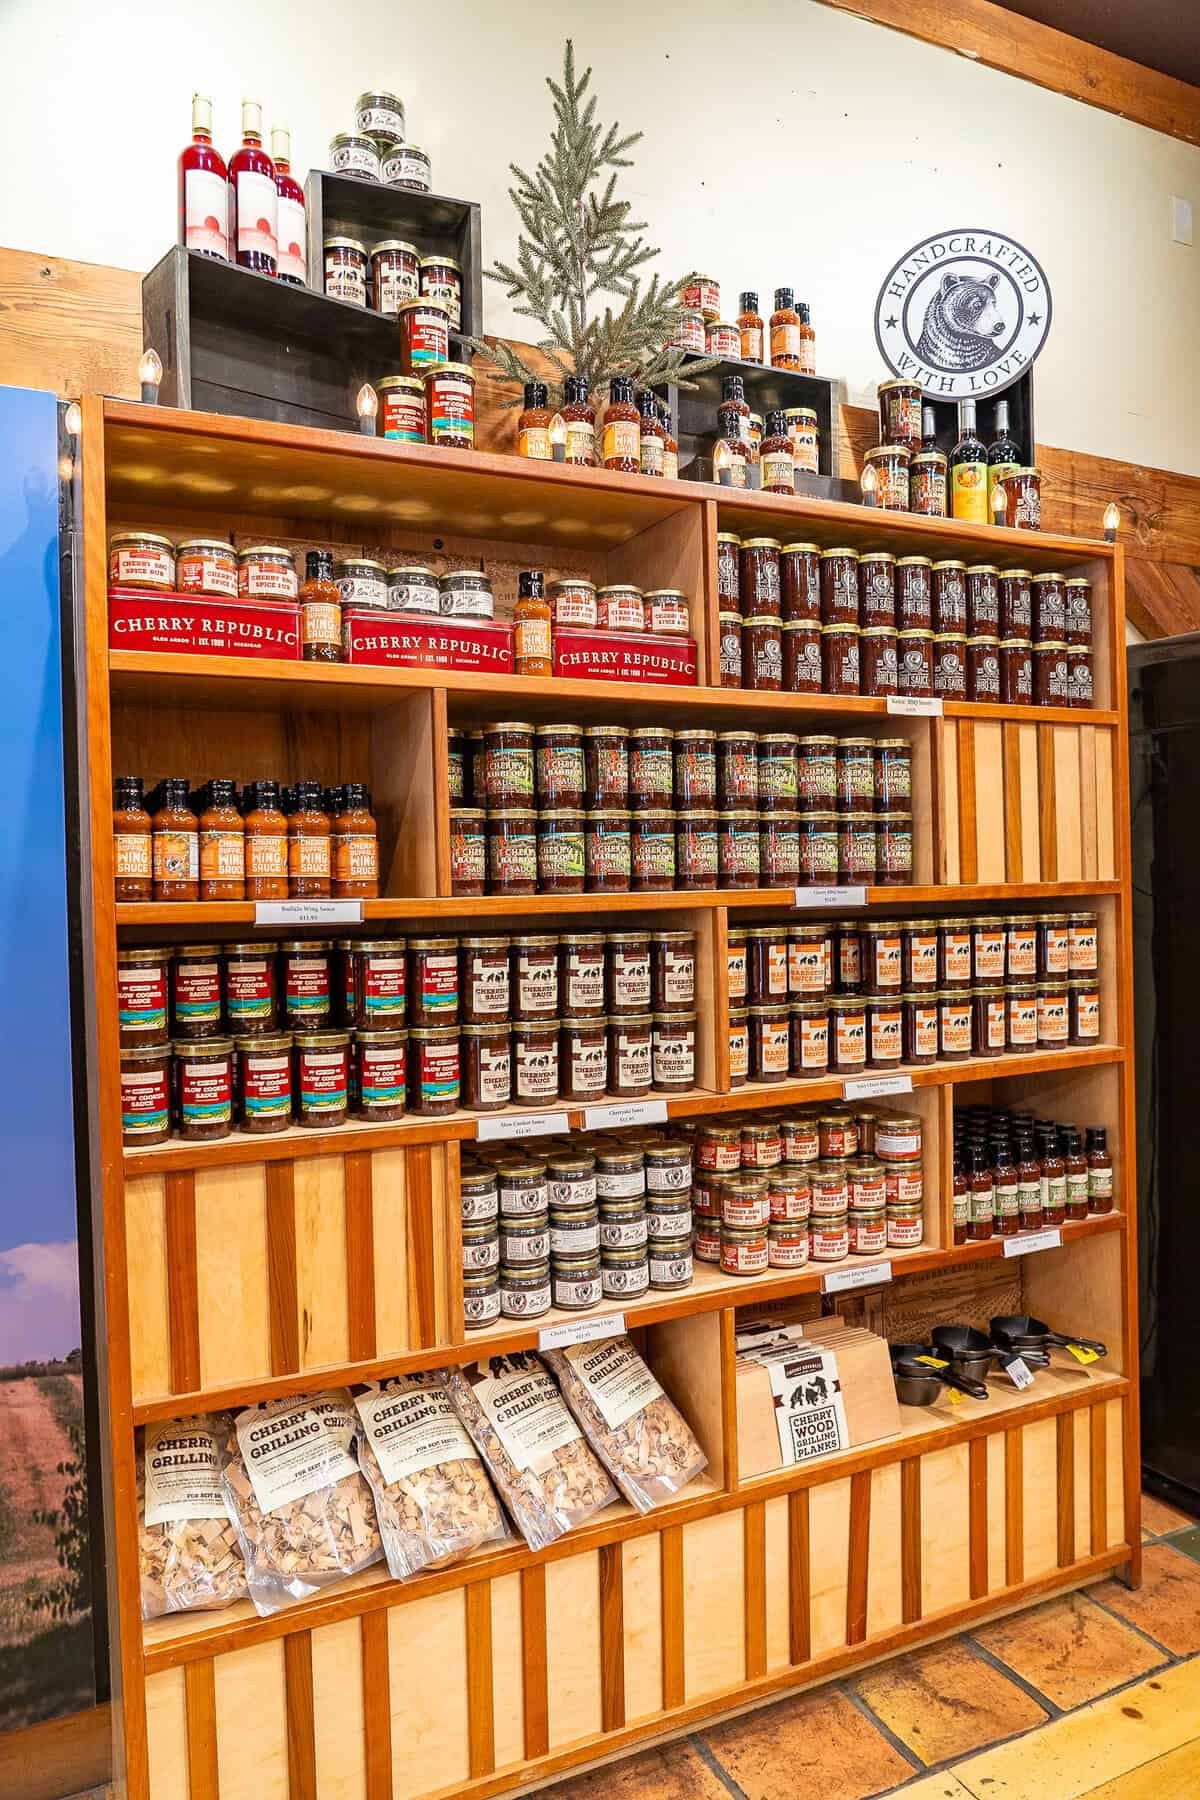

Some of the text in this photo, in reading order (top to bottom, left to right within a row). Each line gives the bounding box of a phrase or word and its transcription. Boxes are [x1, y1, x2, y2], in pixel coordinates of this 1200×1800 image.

[889, 238, 1039, 299] HANDCRAFTED
[897, 350, 1027, 392] WITH LOVE
[114, 617, 297, 646] CHERRY REPUBLIC
[353, 636, 509, 661] CHERRY REPUBLIC
[560, 652, 695, 675] CHERRY REPUBLIC
[118, 852, 147, 863] WING
[118, 864, 148, 872] SAUCE
[252, 852, 280, 862] WING
[252, 864, 281, 872] SAUCE
[301, 852, 327, 863] WING
[301, 864, 328, 872] SAUCE
[583, 1344, 617, 1370] CHERRY
[589, 1353, 629, 1384] GRILLING
[493, 1383, 533, 1408] CHERRY
[497, 1393, 544, 1422] GRILLING
[373, 1394, 425, 1422] CHERRY
[793, 1409, 832, 1427] CHERRY
[250, 1411, 306, 1441] CHERRY
[374, 1406, 436, 1438] GRILLING
[795, 1420, 834, 1438] WOOD
[157, 1437, 212, 1451] CHERRY
[251, 1422, 320, 1459] GRILLING
[796, 1430, 836, 1448] GRILLING
[798, 1439, 836, 1458] PLANKS
